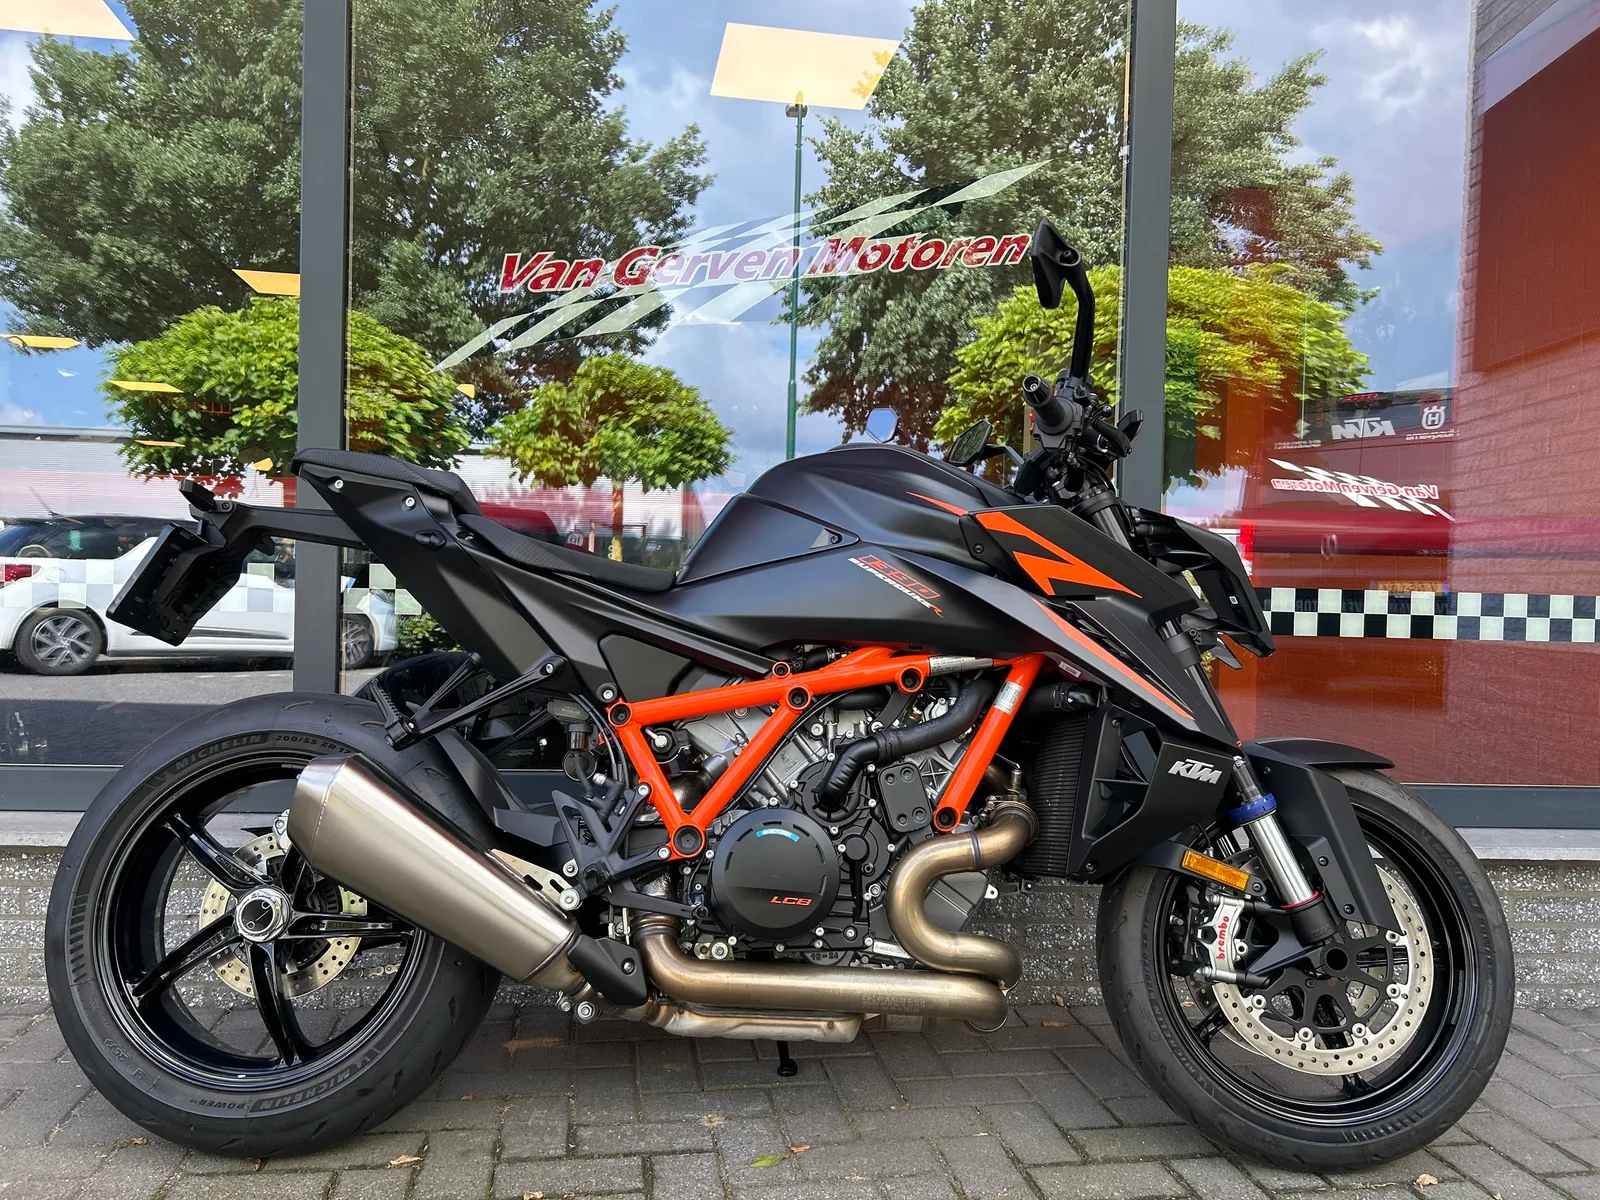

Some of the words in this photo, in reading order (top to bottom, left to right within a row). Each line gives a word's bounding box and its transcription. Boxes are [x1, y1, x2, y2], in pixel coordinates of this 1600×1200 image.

[498, 251, 605, 294] Van
[611, 244, 801, 289] Gerven
[807, 233, 1032, 277] Motoren
[174, 734, 264, 772] MICHELIN
[275, 734, 318, 746] 200/55
[320, 741, 337, 750] ZR
[1167, 758, 1223, 785] KTM
[770, 895, 812, 906] LC8
[1215, 914, 1230, 961] brembo
[1142, 952, 1155, 995] 120/70
[1152, 1003, 1198, 1074] MICHELIN
[199, 1098, 245, 1110] POWER
[259, 1068, 351, 1111] MICHELIN
